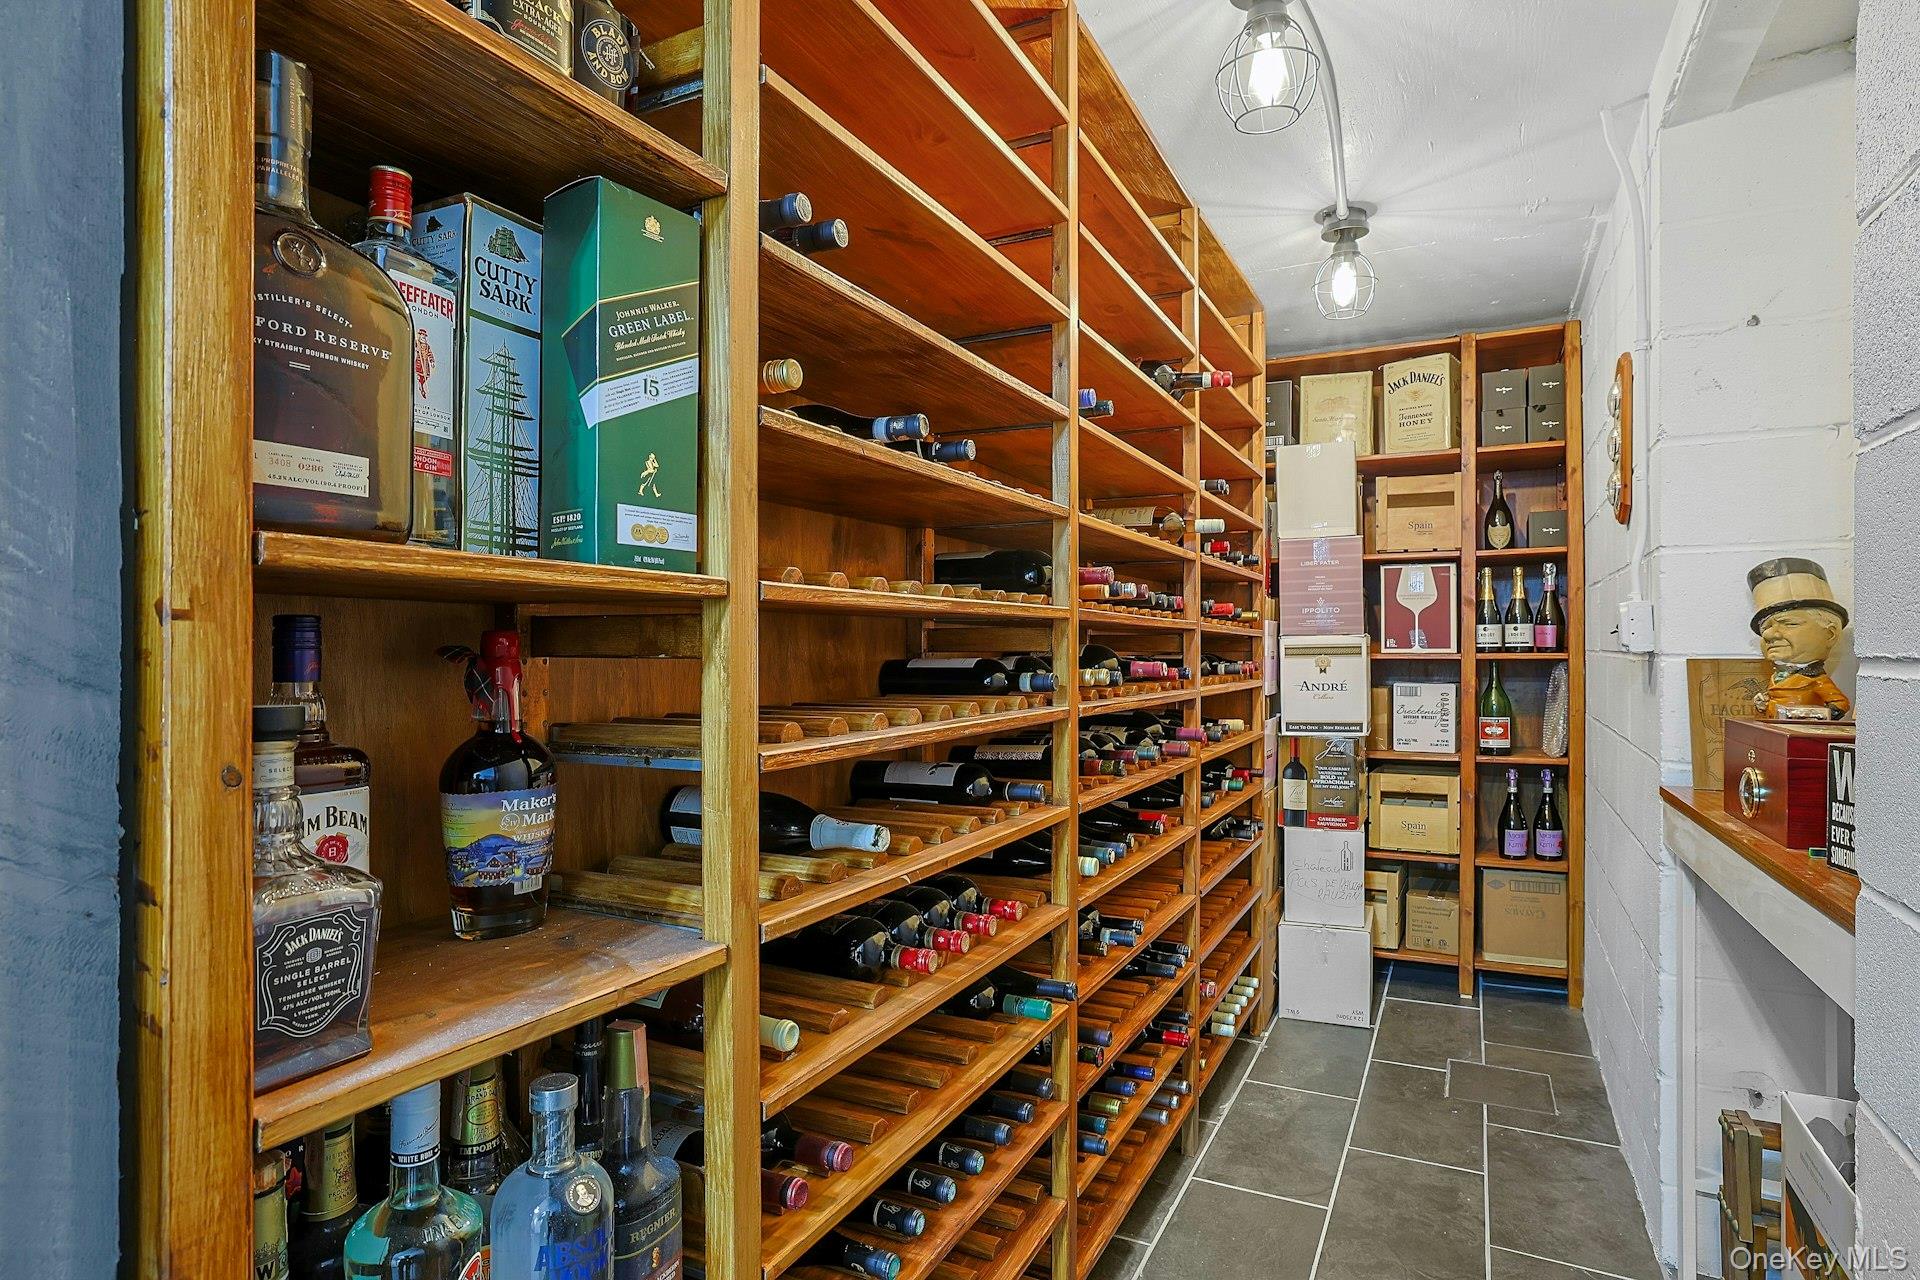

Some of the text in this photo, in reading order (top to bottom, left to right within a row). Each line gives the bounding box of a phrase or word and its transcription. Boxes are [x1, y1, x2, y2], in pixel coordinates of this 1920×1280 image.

[591, 24, 628, 54] BLADE
[586, 50, 629, 84] AND BOW
[412, 236, 434, 246] CUTTY
[474, 256, 538, 294] CUTTY
[411, 304, 439, 319] ONDON
[616, 306, 648, 321] JOHNNIE
[609, 319, 651, 338] GREEN
[256, 316, 391, 360] FORD RESERVE
[265, 339, 303, 353] STRAIGHT
[305, 349, 339, 363] BOURBON
[340, 357, 370, 370] WHISKEY
[643, 378, 660, 397] 15
[1388, 371, 1445, 394] JACK DANIEL'S
[1399, 412, 1433, 421] Tennessee
[1399, 418, 1433, 428] HONEY
[268, 457, 291, 468] 3408
[298, 462, 324, 473] 0286
[424, 463, 437, 471] GIN
[288, 476, 320, 486] ALC/VOL
[567, 512, 582, 523] 1820
[1408, 521, 1433, 531] Spain
[1300, 680, 1348, 692] ANDRÉ
[325, 806, 368, 838] BEAM
[521, 807, 555, 828] Mark
[1401, 820, 1427, 831] Spain
[513, 828, 551, 842] WHISKY
[1831, 825, 1850, 846] EVER
[284, 927, 344, 956] JACK DANIEL'S
[273, 956, 352, 986] SINGLE BARREL
[297, 972, 331, 988] SELECT
[278, 978, 346, 1003] TENNESSEE WHISKEY
[282, 988, 342, 1011] 47% ALC/VOL 750ML
[293, 1001, 331, 1018] LYNCHBURG
[398, 1150, 434, 1164] WHITE RUM
[629, 1208, 677, 1243] REGNIER
